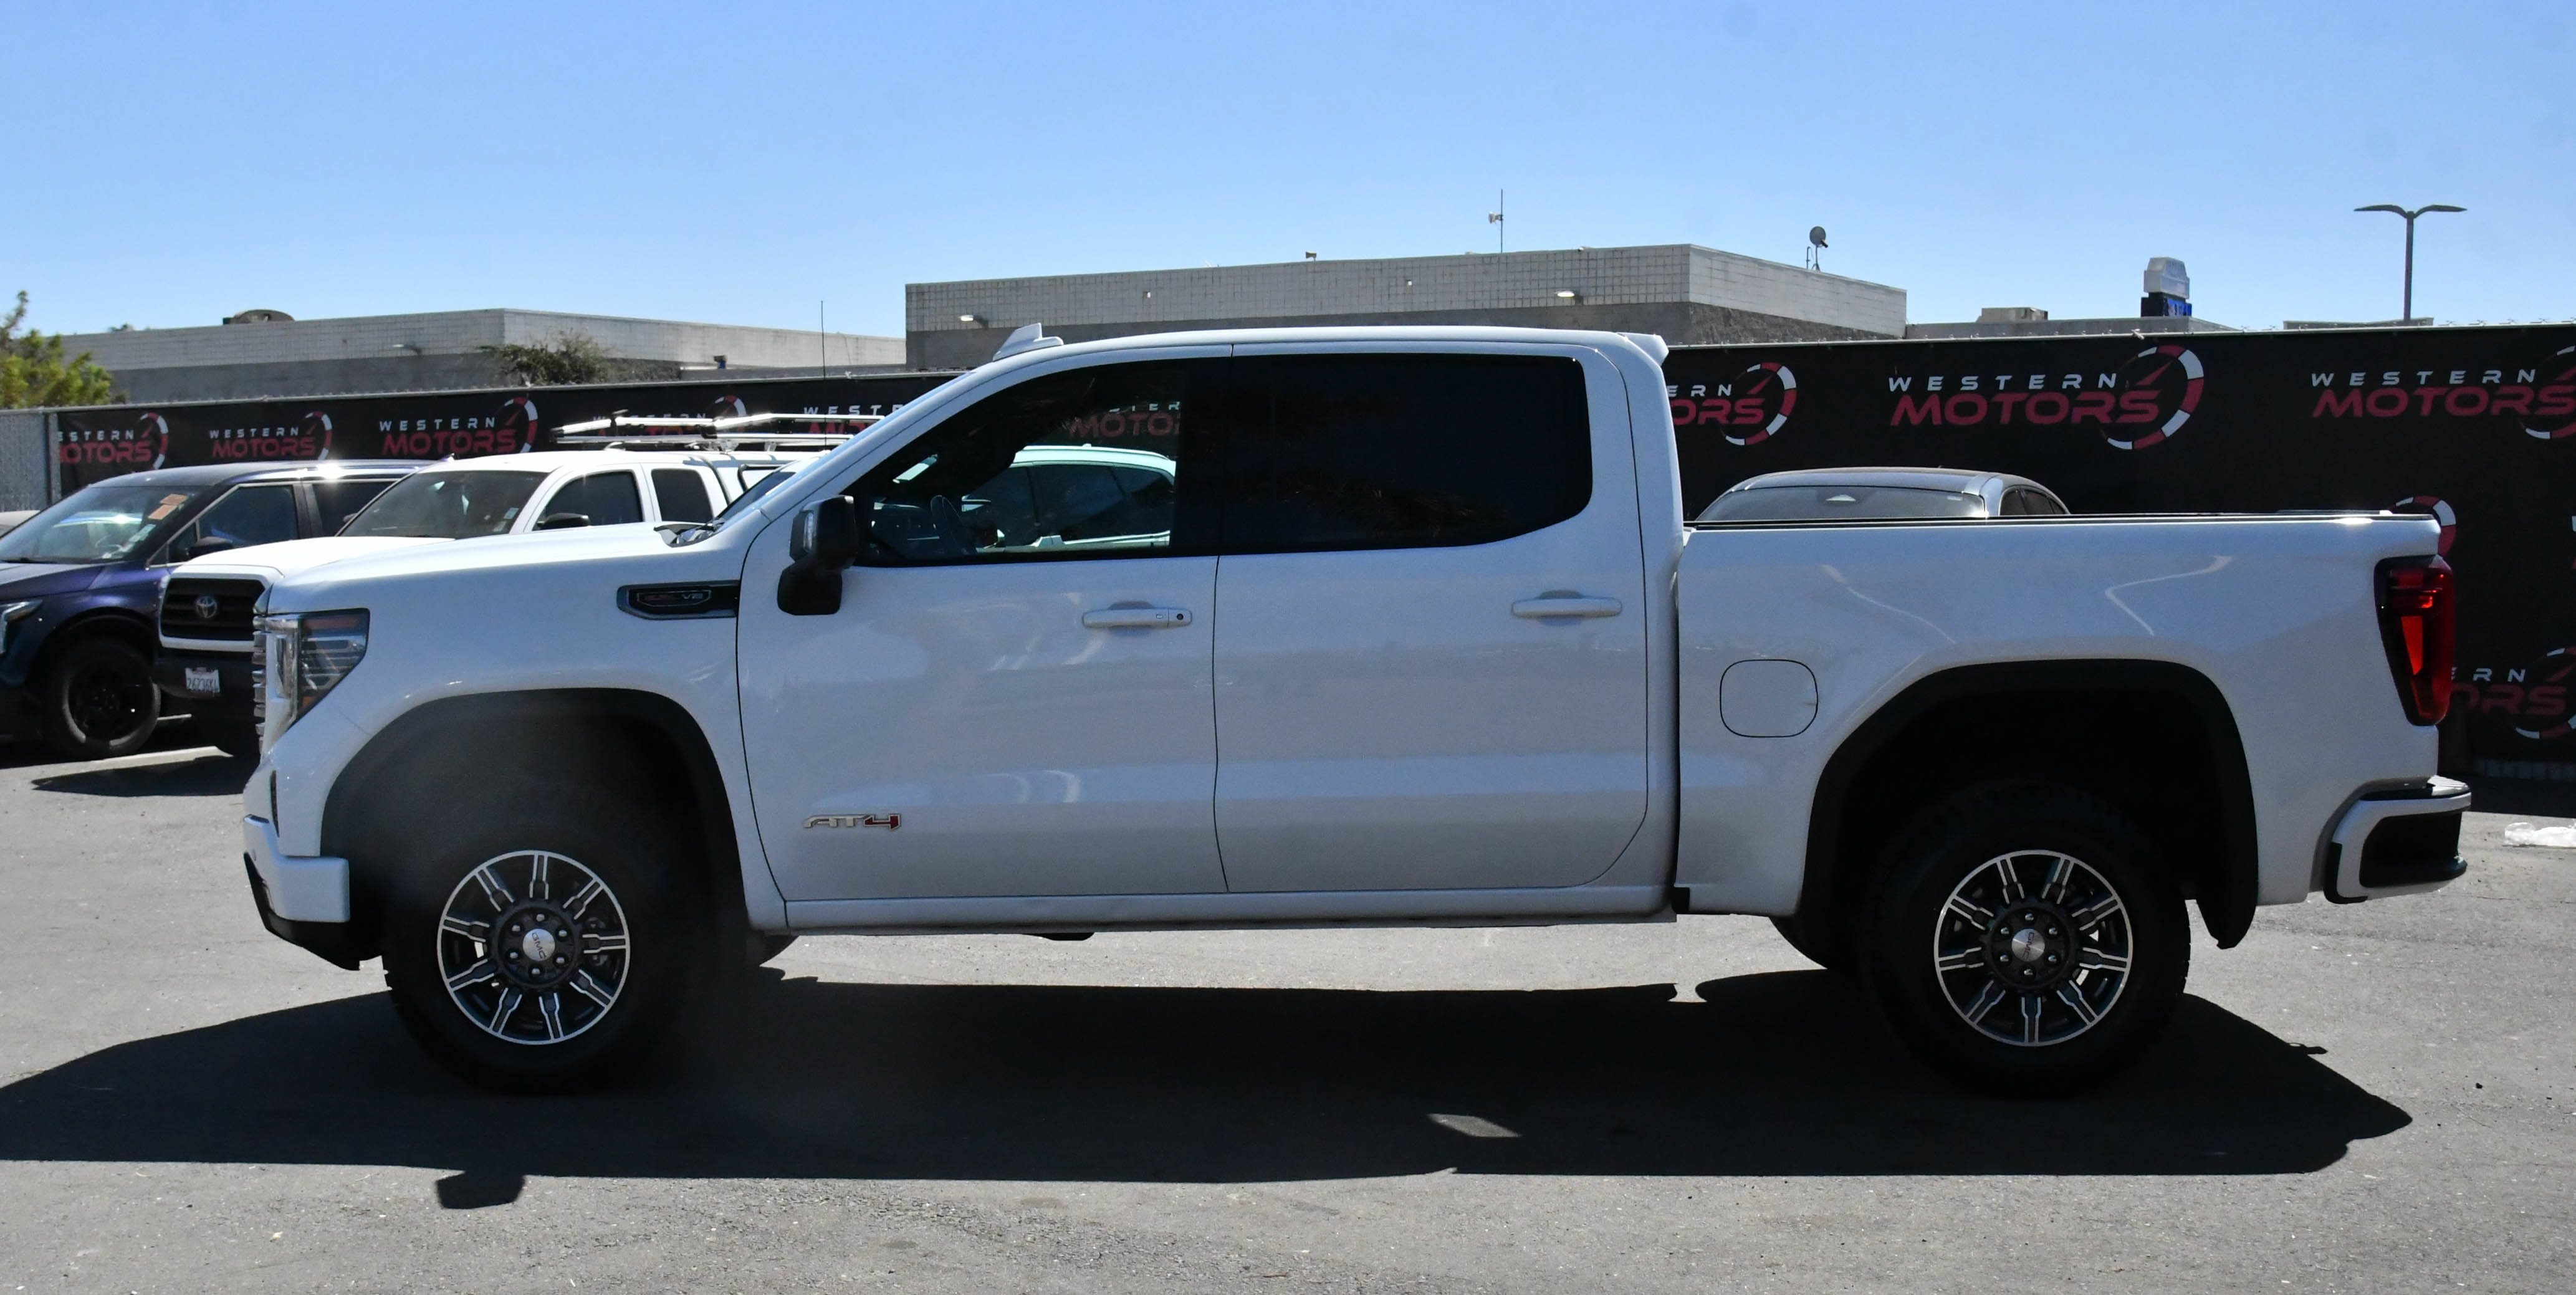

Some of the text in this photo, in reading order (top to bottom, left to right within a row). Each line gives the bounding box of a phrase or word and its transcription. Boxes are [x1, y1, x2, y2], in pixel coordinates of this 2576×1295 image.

[1888, 373, 2117, 392] WESTERN
[2310, 369, 2536, 387] WESTERN
[1670, 398, 1766, 426] ORS
[1890, 389, 2162, 426] MOTORS
[2312, 385, 2576, 418] MOTORS
[209, 426, 299, 439] WESTERN
[379, 417, 496, 432] WESTERN
[57, 430, 134, 442] ESTERN
[381, 428, 517, 456] MOTORS
[60, 441, 152, 464] OTORS
[212, 437, 315, 458] MOTORS
[803, 813, 901, 831] AT4
[532, 931, 547, 959] GMC
[2022, 932, 2035, 959] GMC
